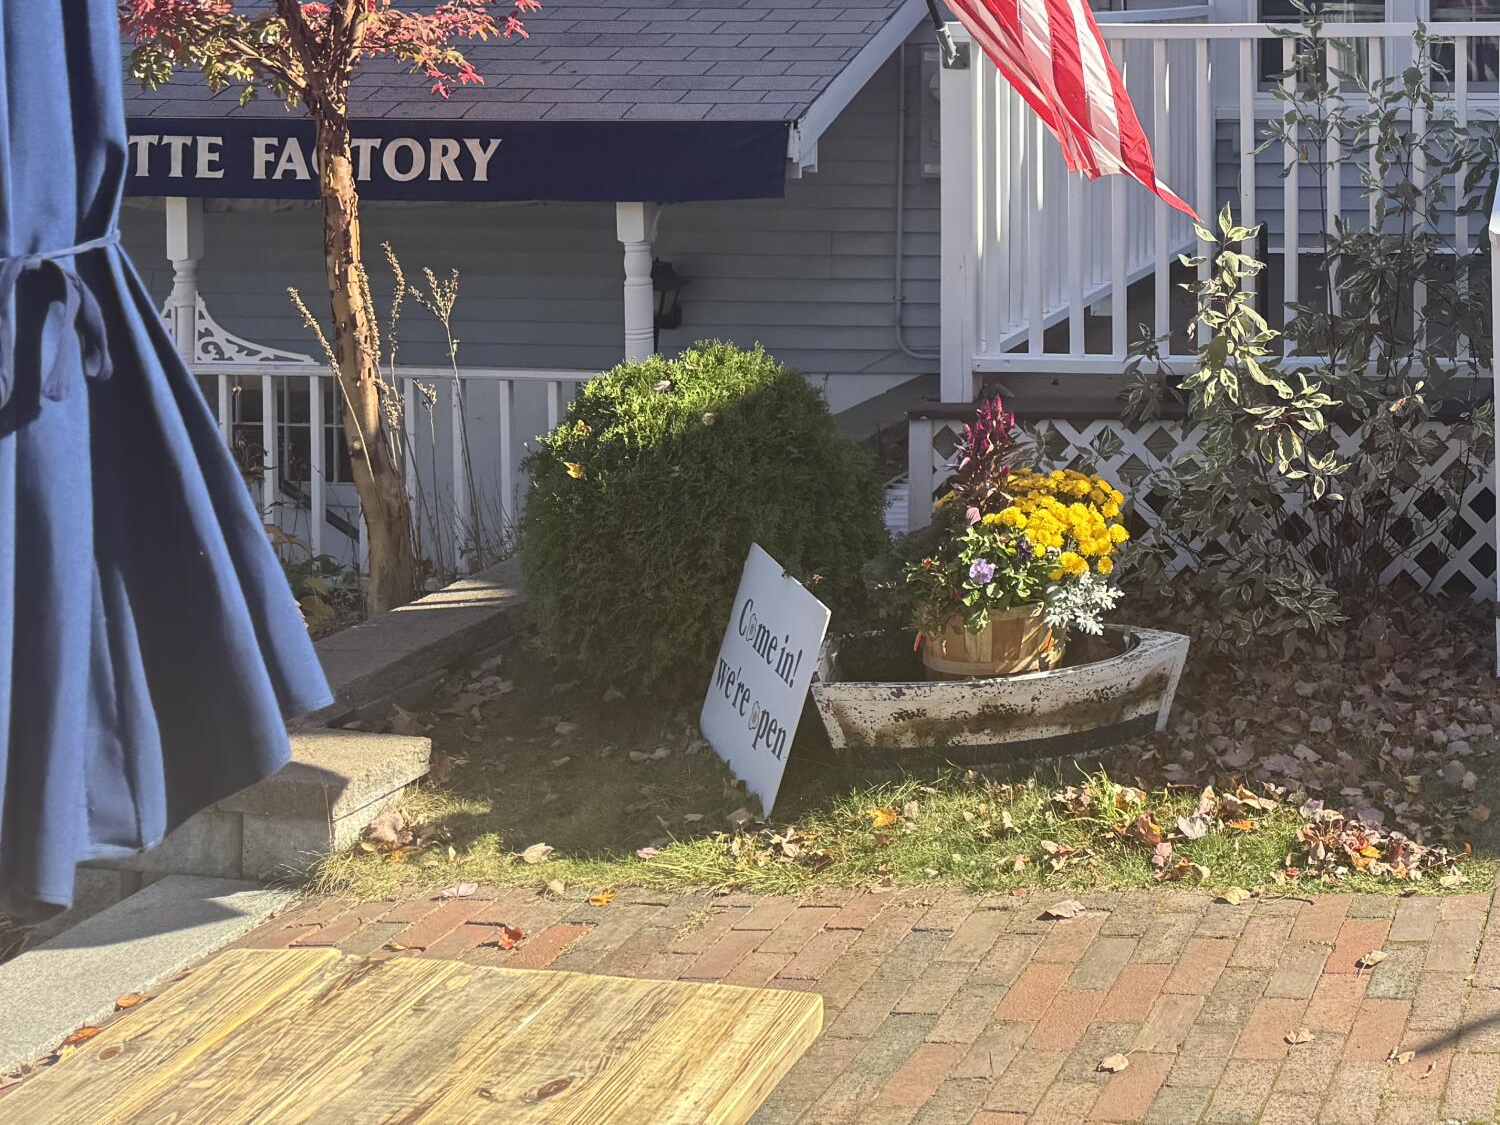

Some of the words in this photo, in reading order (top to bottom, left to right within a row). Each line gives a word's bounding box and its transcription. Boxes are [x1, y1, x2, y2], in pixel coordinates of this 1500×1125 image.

[252, 137, 502, 182] FATORY
[738, 598, 777, 665] Come
[775, 634, 803, 688] in!
[716, 657, 751, 717] we're
[748, 700, 787, 761] open
